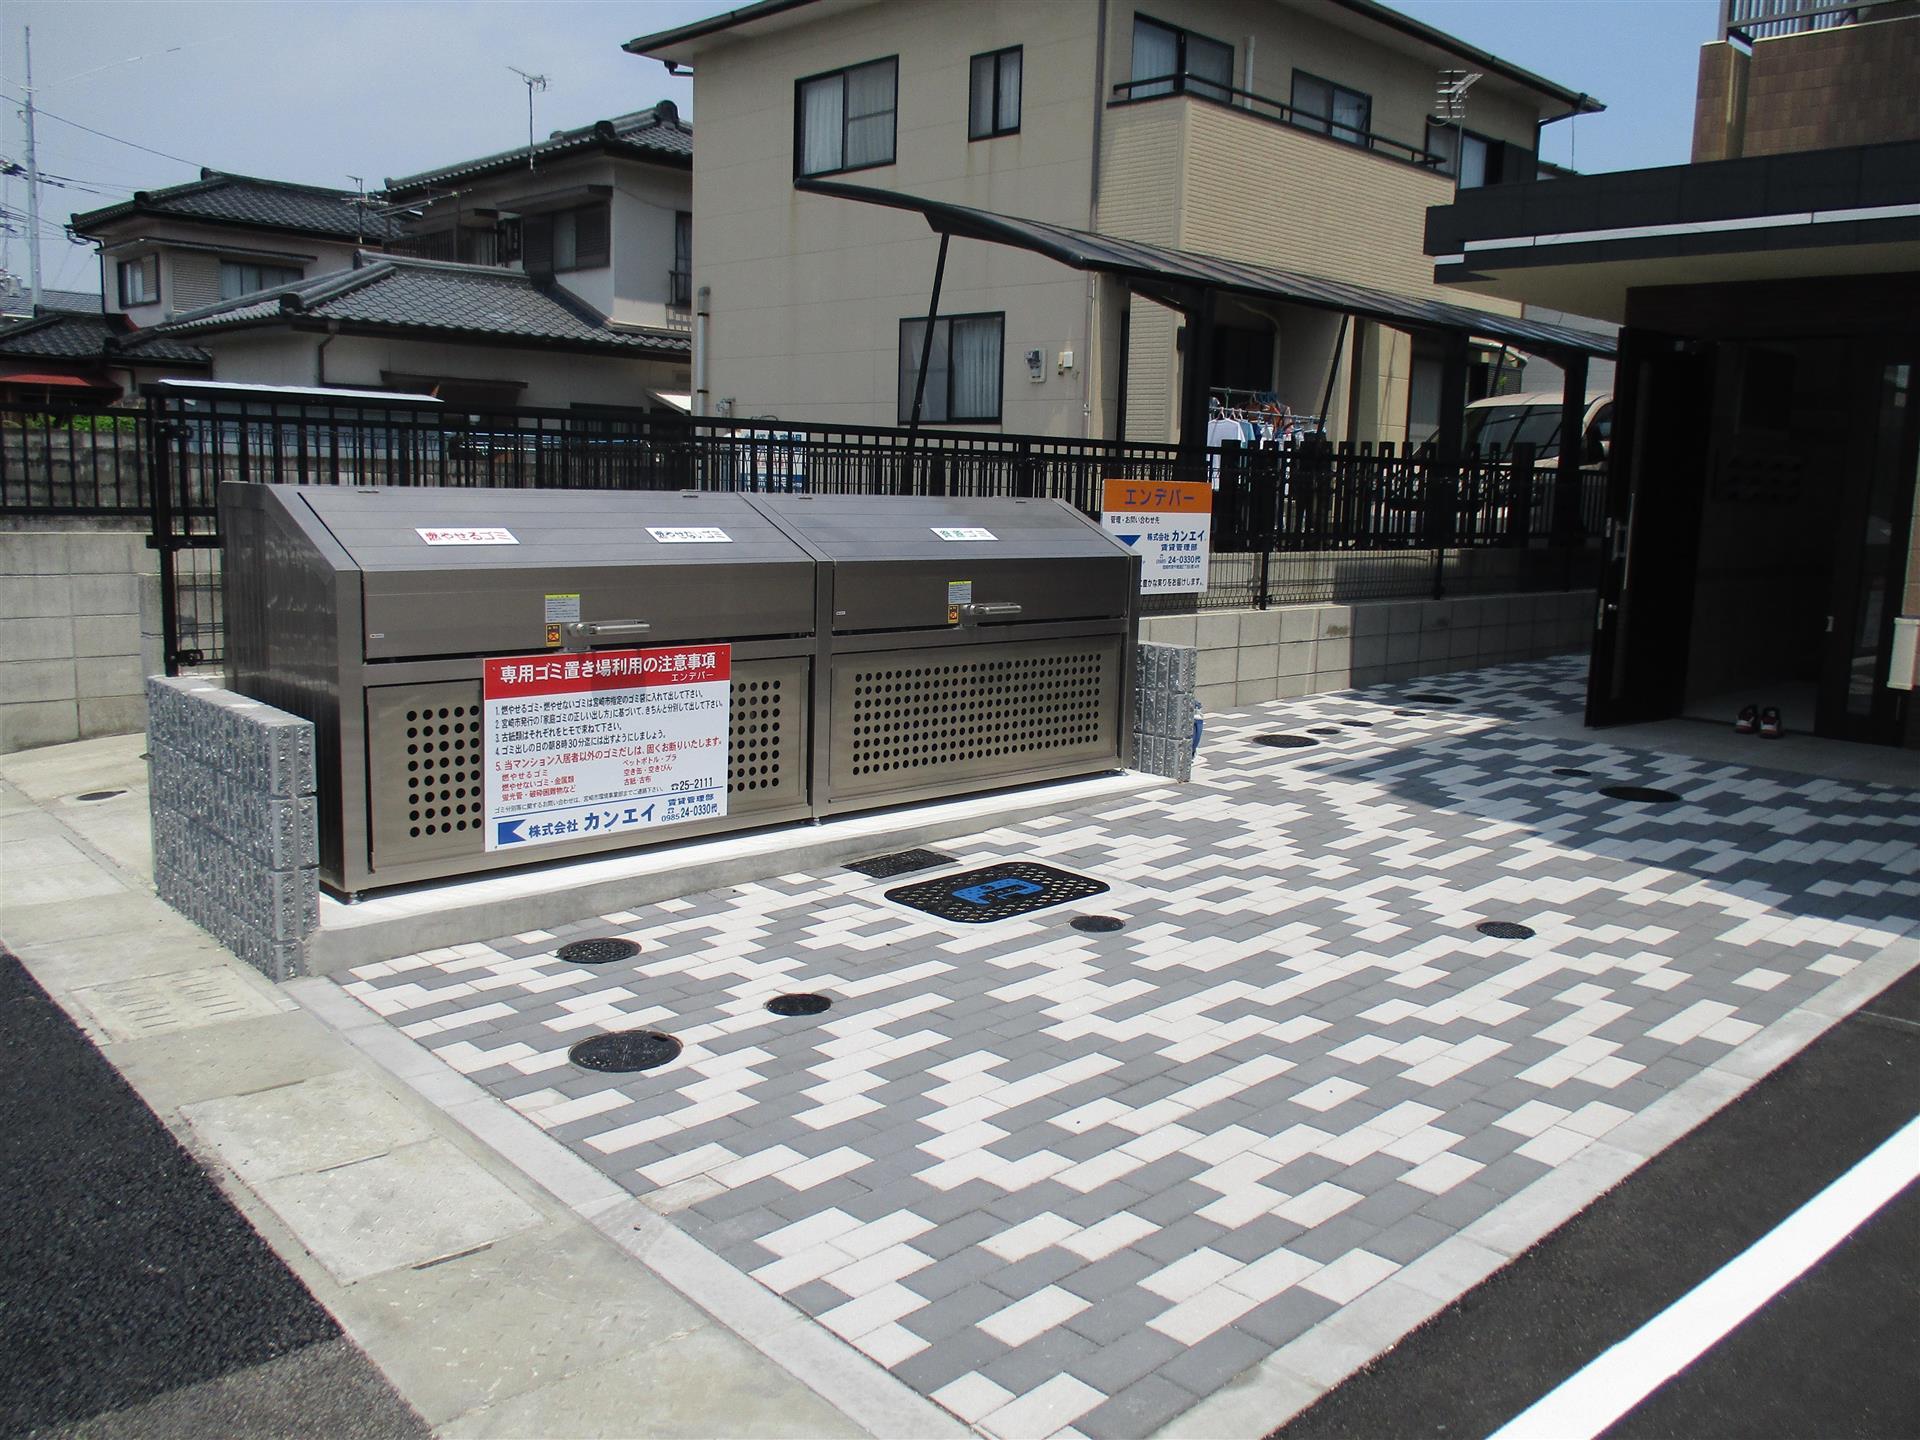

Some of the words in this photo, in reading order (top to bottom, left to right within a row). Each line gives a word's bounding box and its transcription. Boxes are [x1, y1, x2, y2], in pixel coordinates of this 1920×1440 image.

[1172, 530, 1205, 542] カンエイ
[500, 651, 716, 684] 専用ゴミ置き場利用の注意事項
[671, 672, 714, 682] エンデバー
[501, 769, 549, 782] 燃やせるゴミ
[528, 818, 578, 839] 株式会社
[584, 803, 656, 832] カンエイ
[661, 813, 680, 822] 0985
